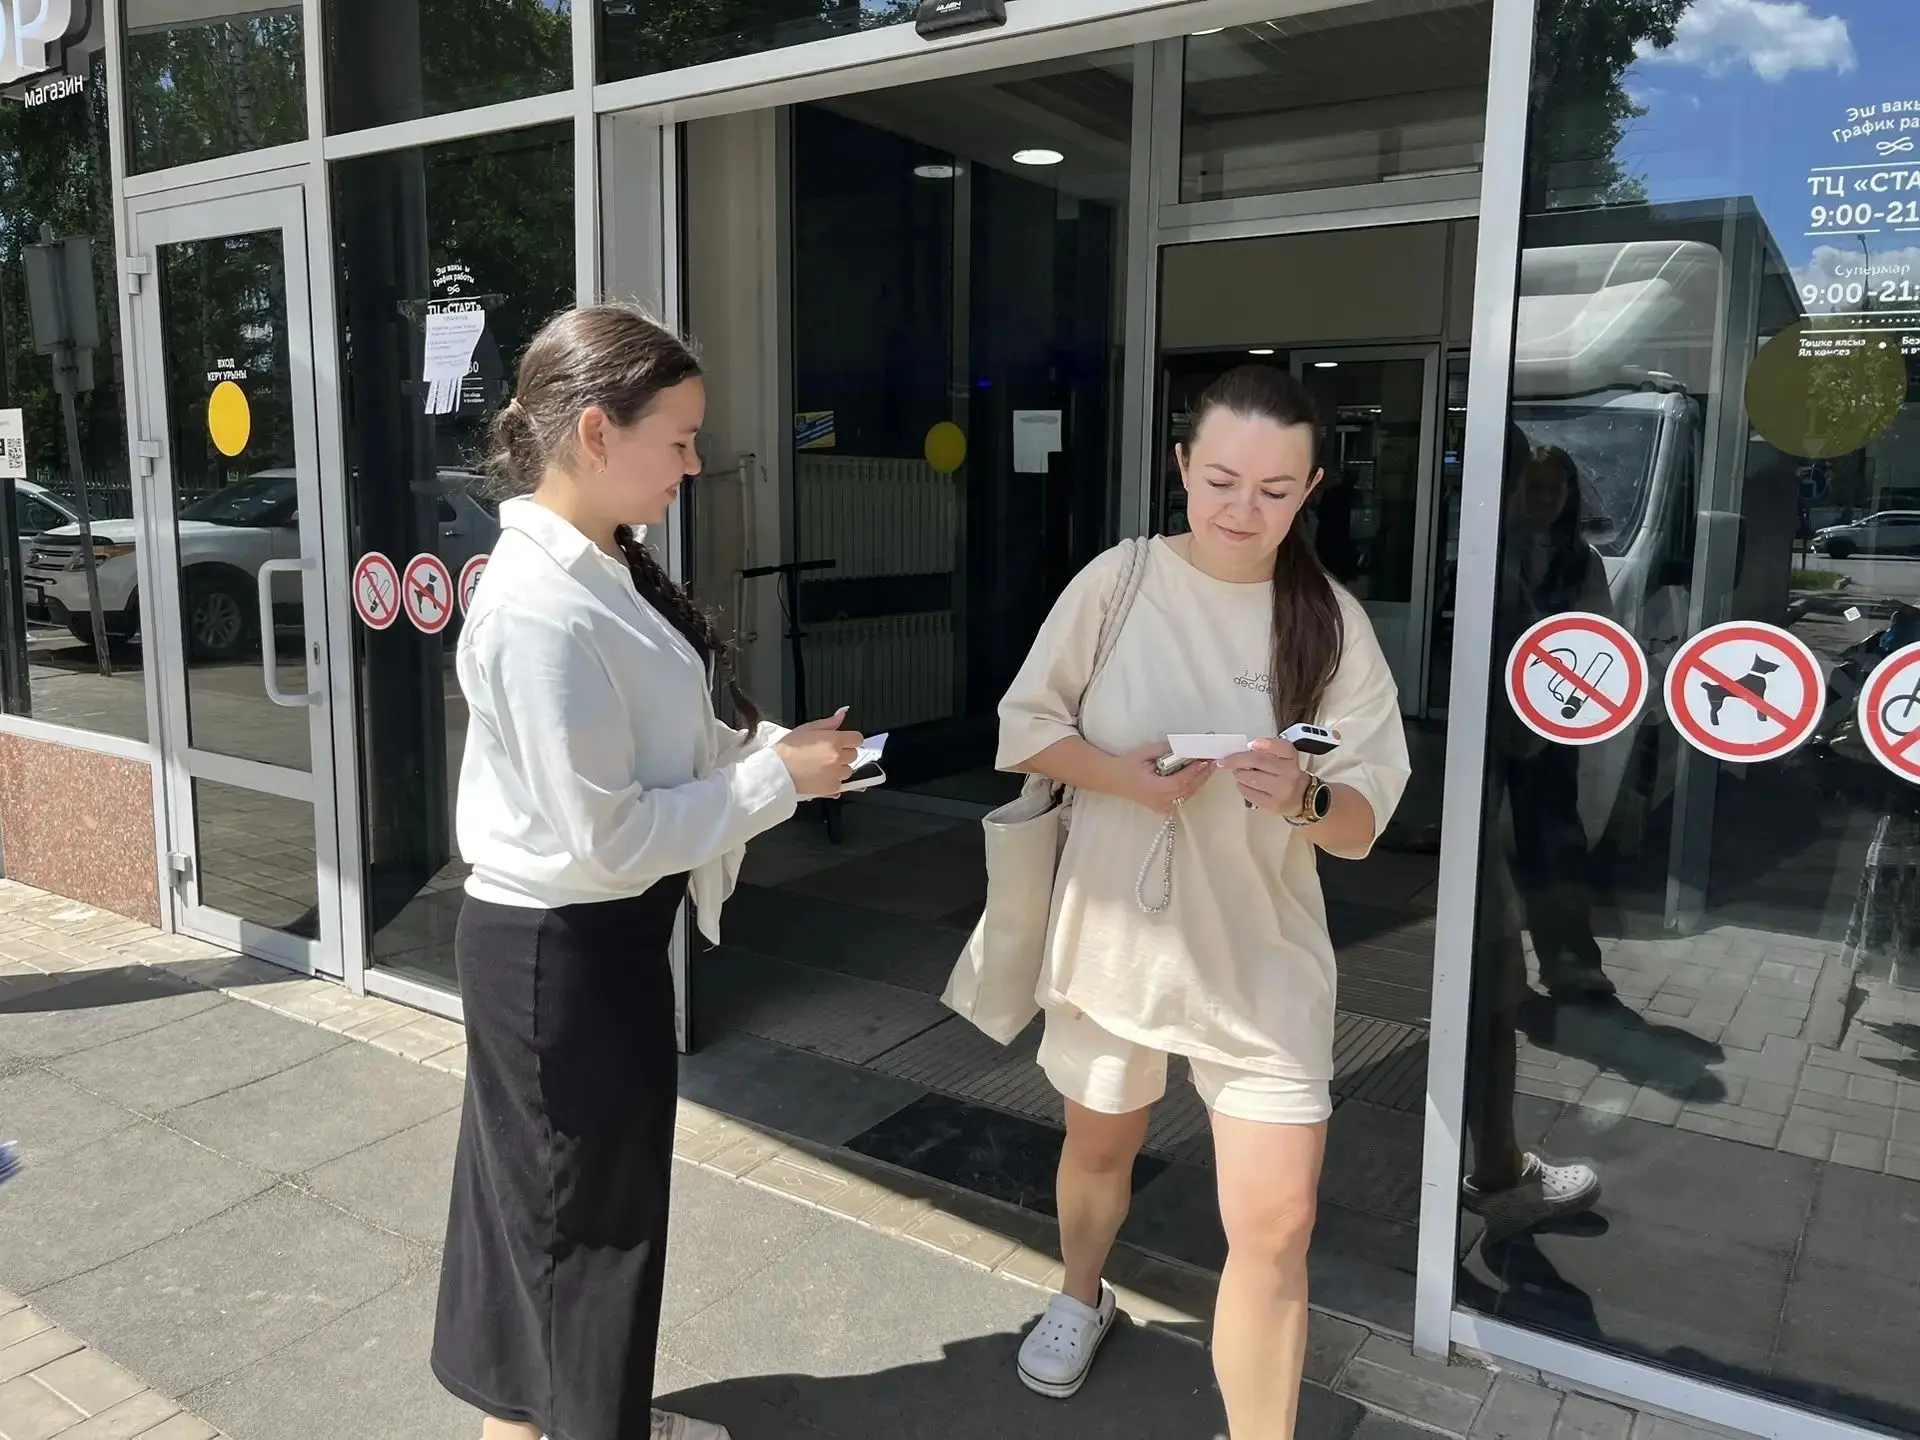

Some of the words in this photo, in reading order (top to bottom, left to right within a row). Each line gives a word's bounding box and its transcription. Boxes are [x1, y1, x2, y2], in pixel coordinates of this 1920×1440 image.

[24, 75, 84, 108] магазин
[1845, 104, 1876, 122] Эш
[1831, 118, 1895, 143] График
[1899, 116, 1920, 131] ра
[1807, 175, 1844, 197] ТЦ
[1801, 280, 1920, 305] 9:00-21:
[217, 358, 235, 369] ВХОД
[223, 370, 247, 380] УРЫНЫ
[1233, 676, 1273, 694] decide
